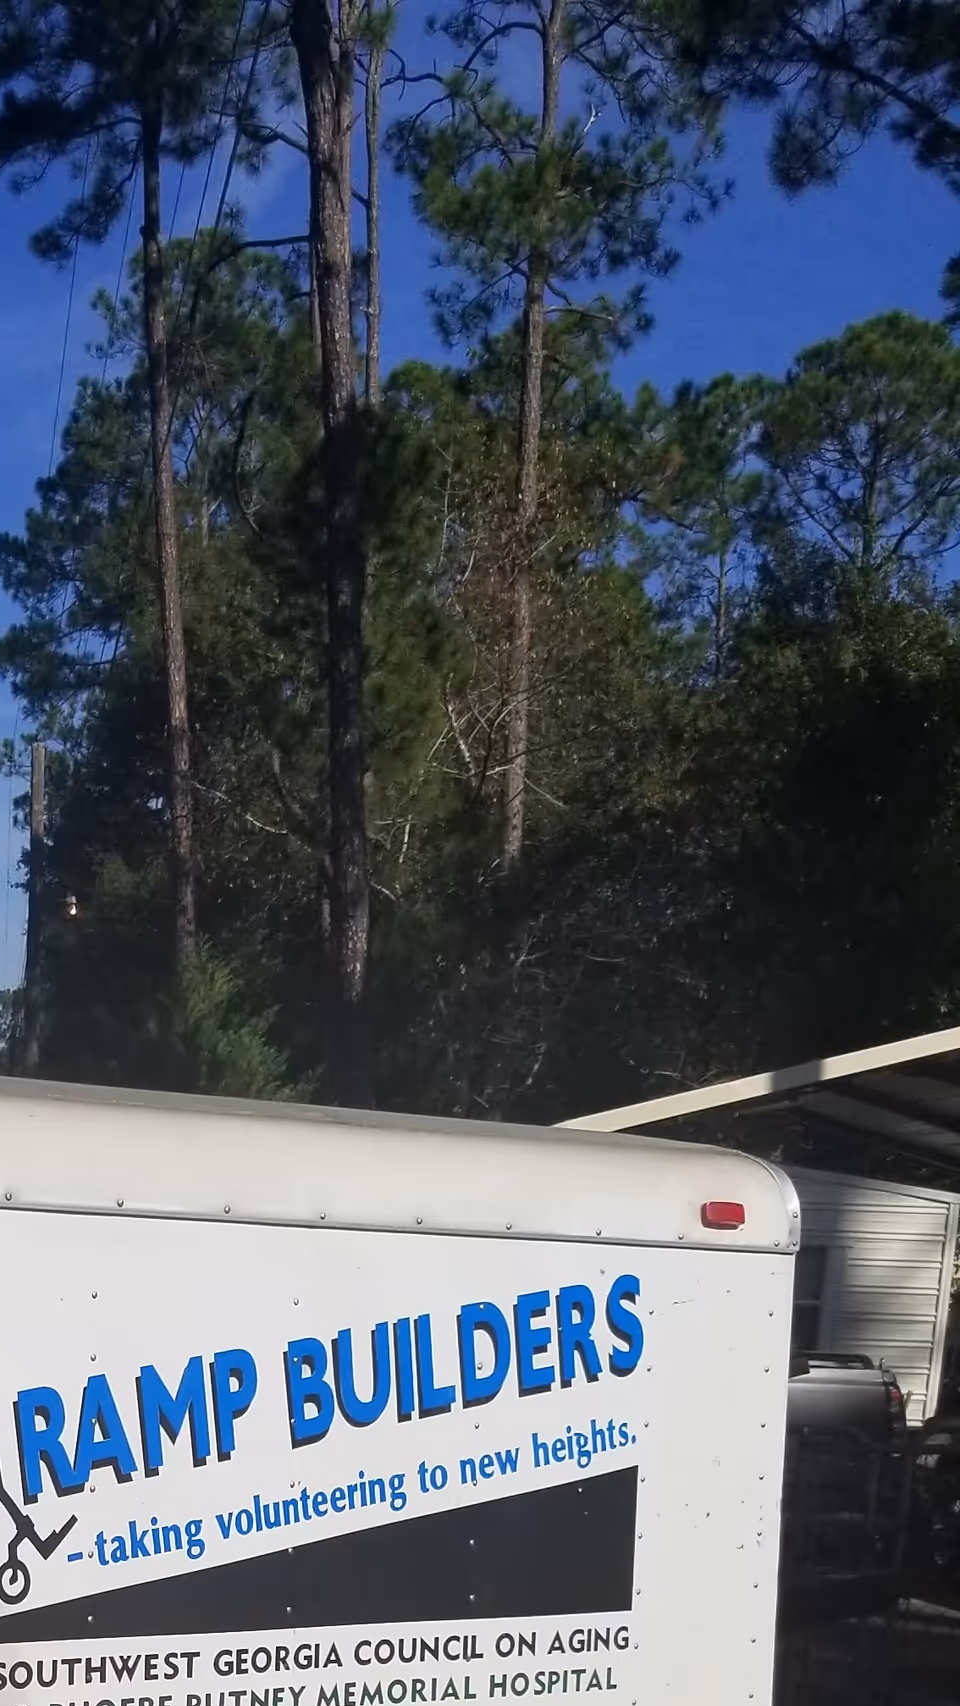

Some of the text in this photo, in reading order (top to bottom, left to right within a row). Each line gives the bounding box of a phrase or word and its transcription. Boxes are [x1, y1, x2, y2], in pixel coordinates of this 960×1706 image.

[11, 1274, 645, 1506] RAMP BUILDERS
[215, 1470, 408, 1540] volunteering
[417, 1460, 448, 1494] to
[459, 1447, 520, 1487] new
[532, 1418, 637, 1469] heights.
[213, 1642, 344, 1677] GEORGIA
[353, 1634, 484, 1666] COUNCIL
[495, 1631, 537, 1658] ON
[546, 1625, 630, 1655] AGING
[489, 1666, 618, 1698] HOSPITAL
